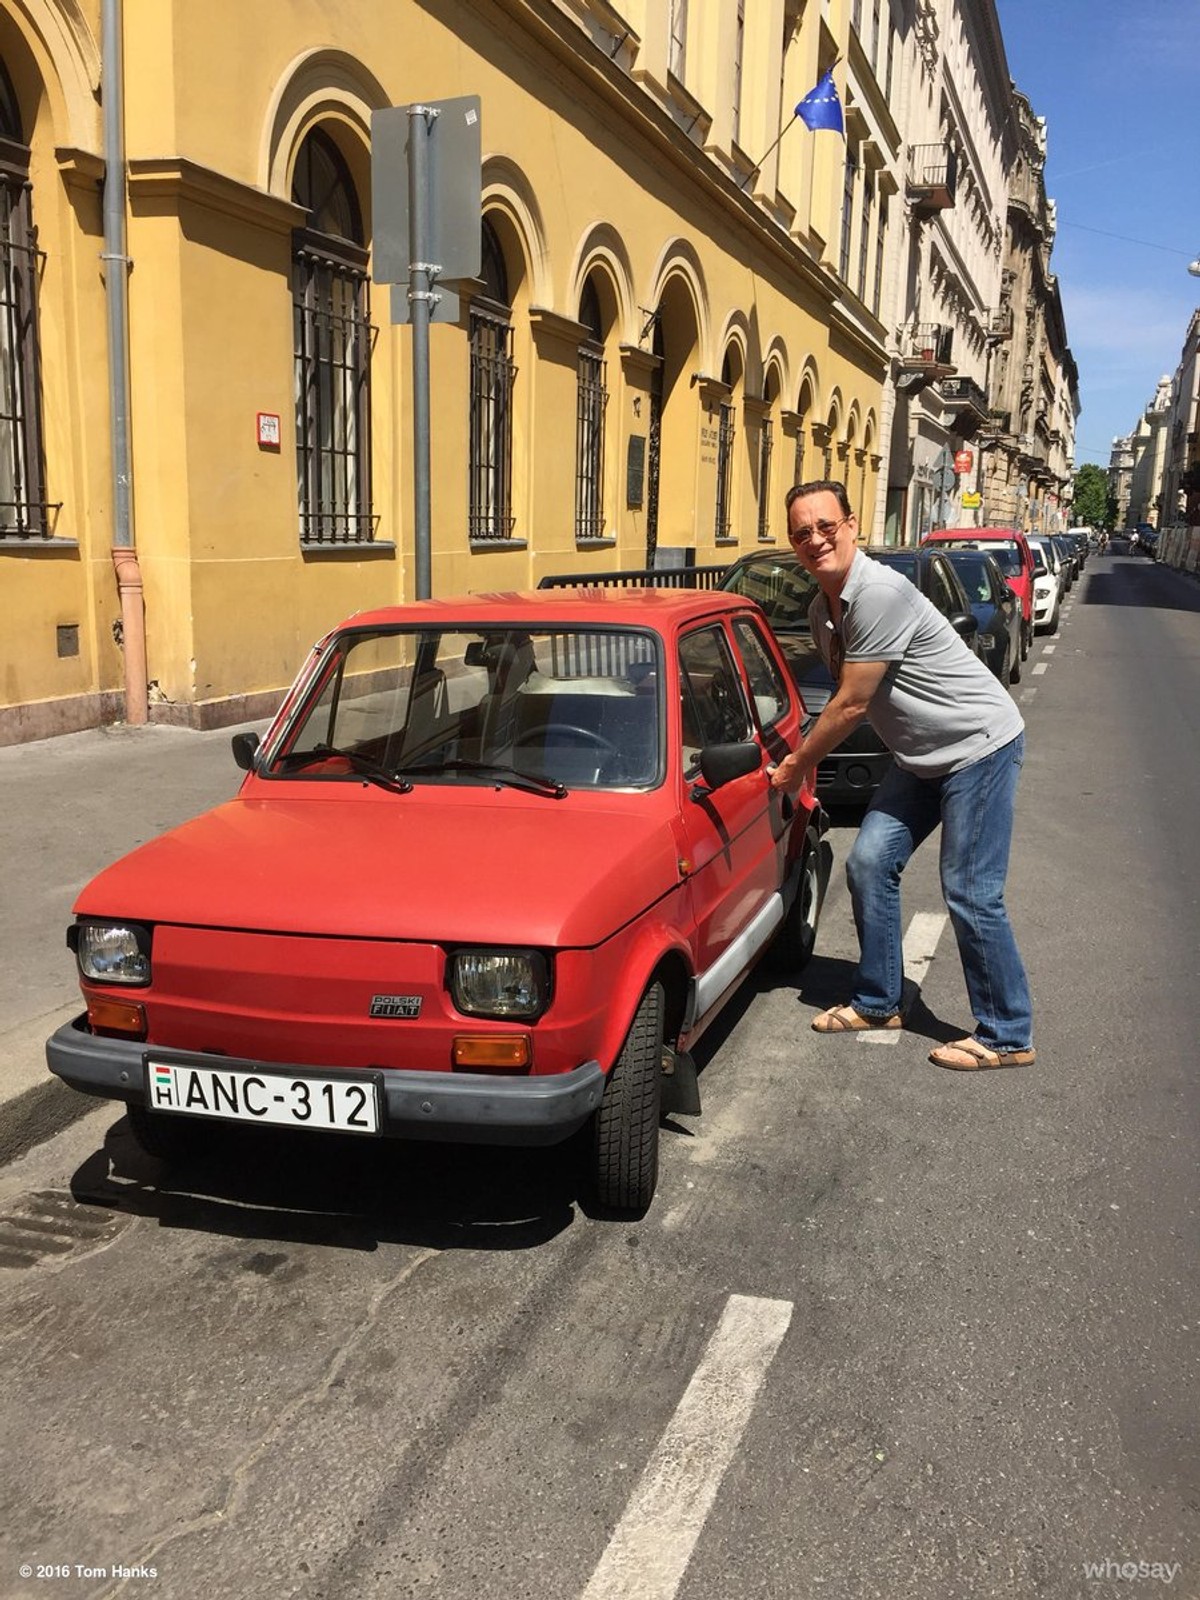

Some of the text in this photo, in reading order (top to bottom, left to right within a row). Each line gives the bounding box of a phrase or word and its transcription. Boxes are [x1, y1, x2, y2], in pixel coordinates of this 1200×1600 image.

[374, 996, 419, 1005] POLSKI
[373, 1005, 417, 1015] FIAT
[156, 1071, 369, 1127] H ANC-312
